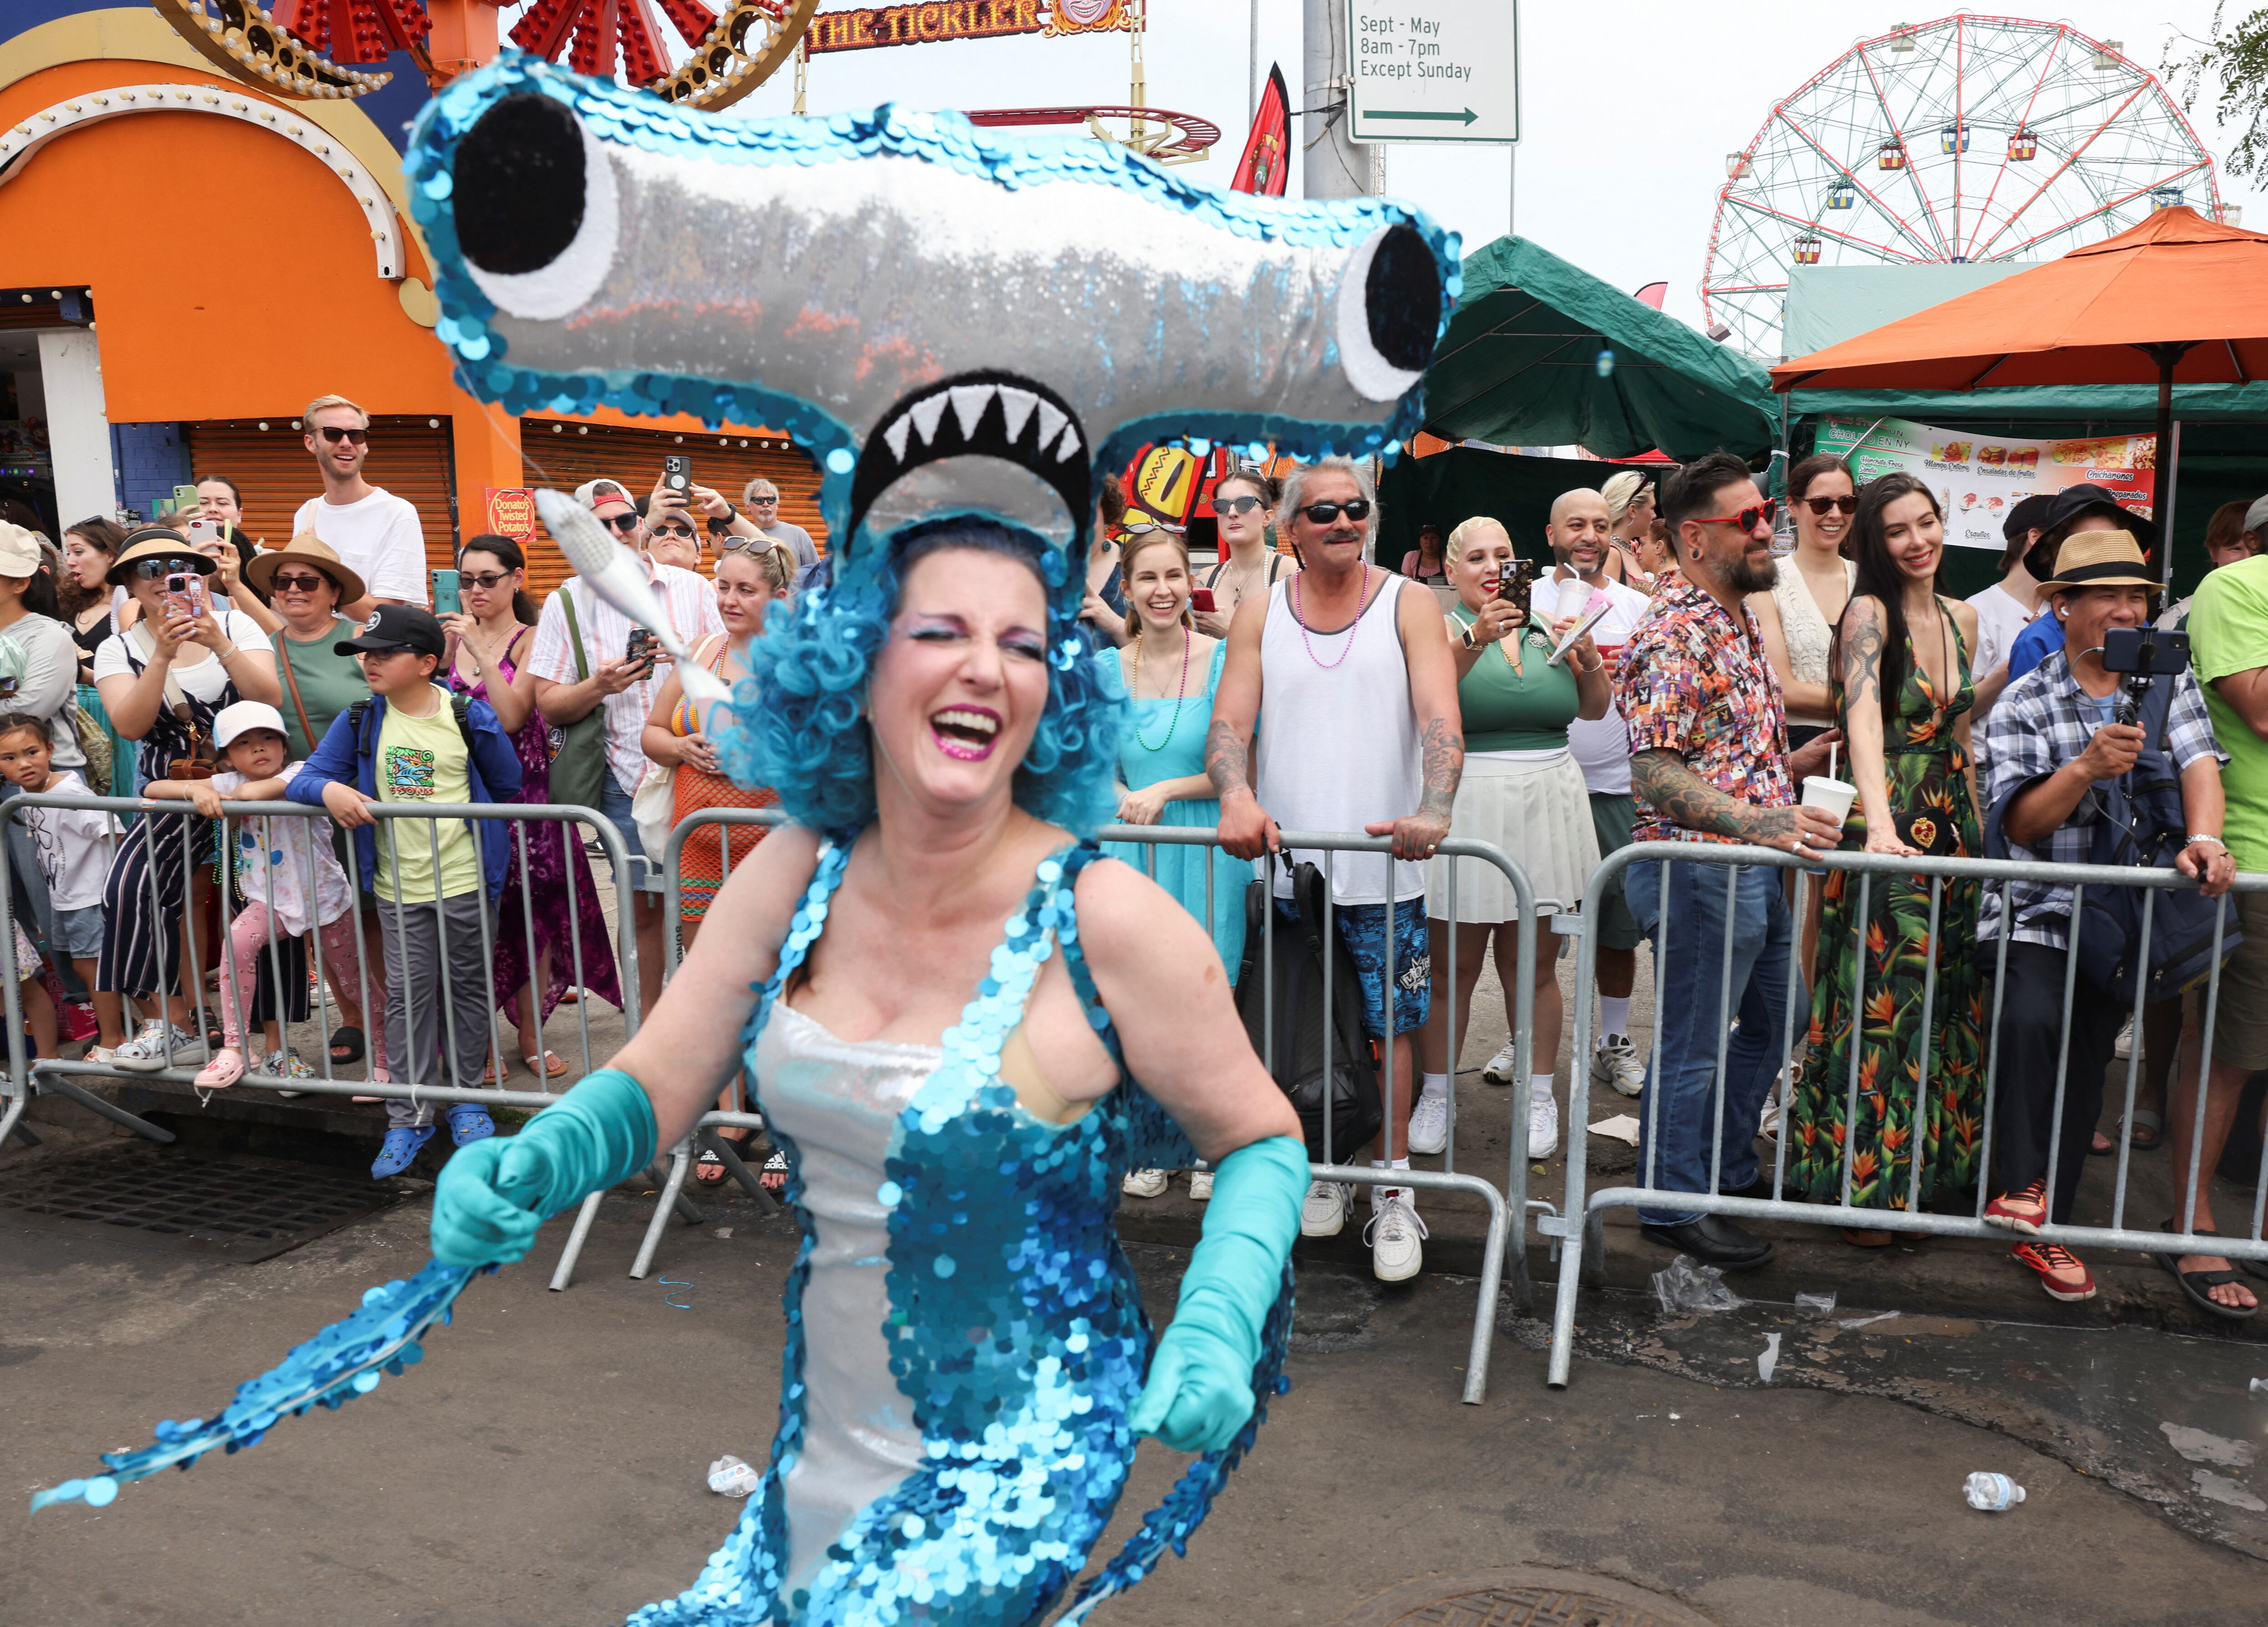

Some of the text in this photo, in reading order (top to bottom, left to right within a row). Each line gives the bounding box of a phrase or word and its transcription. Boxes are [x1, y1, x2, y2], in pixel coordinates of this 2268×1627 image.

[809, 0, 1041, 50] THE TICKLER
[1360, 16, 1394, 36] Sept
[1411, 17, 1440, 37] May
[1361, 38, 1393, 55] 8am
[1409, 39, 1440, 58] 7pm
[1361, 60, 1471, 82] Except Sunday
[1879, 436, 1892, 446] EN
[1896, 439, 1910, 448] NY
[1861, 456, 1904, 469] Horchata Fresa
[1924, 459, 1969, 472] Mango Entero
[1977, 467, 2007, 476] Ensaladas
[2017, 469, 2036, 479] frutas
[2086, 469, 2135, 481] Chicharones
[495, 498, 529, 510] Donato's
[497, 510, 528, 521] Twisted
[498, 521, 529, 532] Potato's
[1965, 529, 1991, 540] Esquites
[397, 786, 434, 796] SONS
